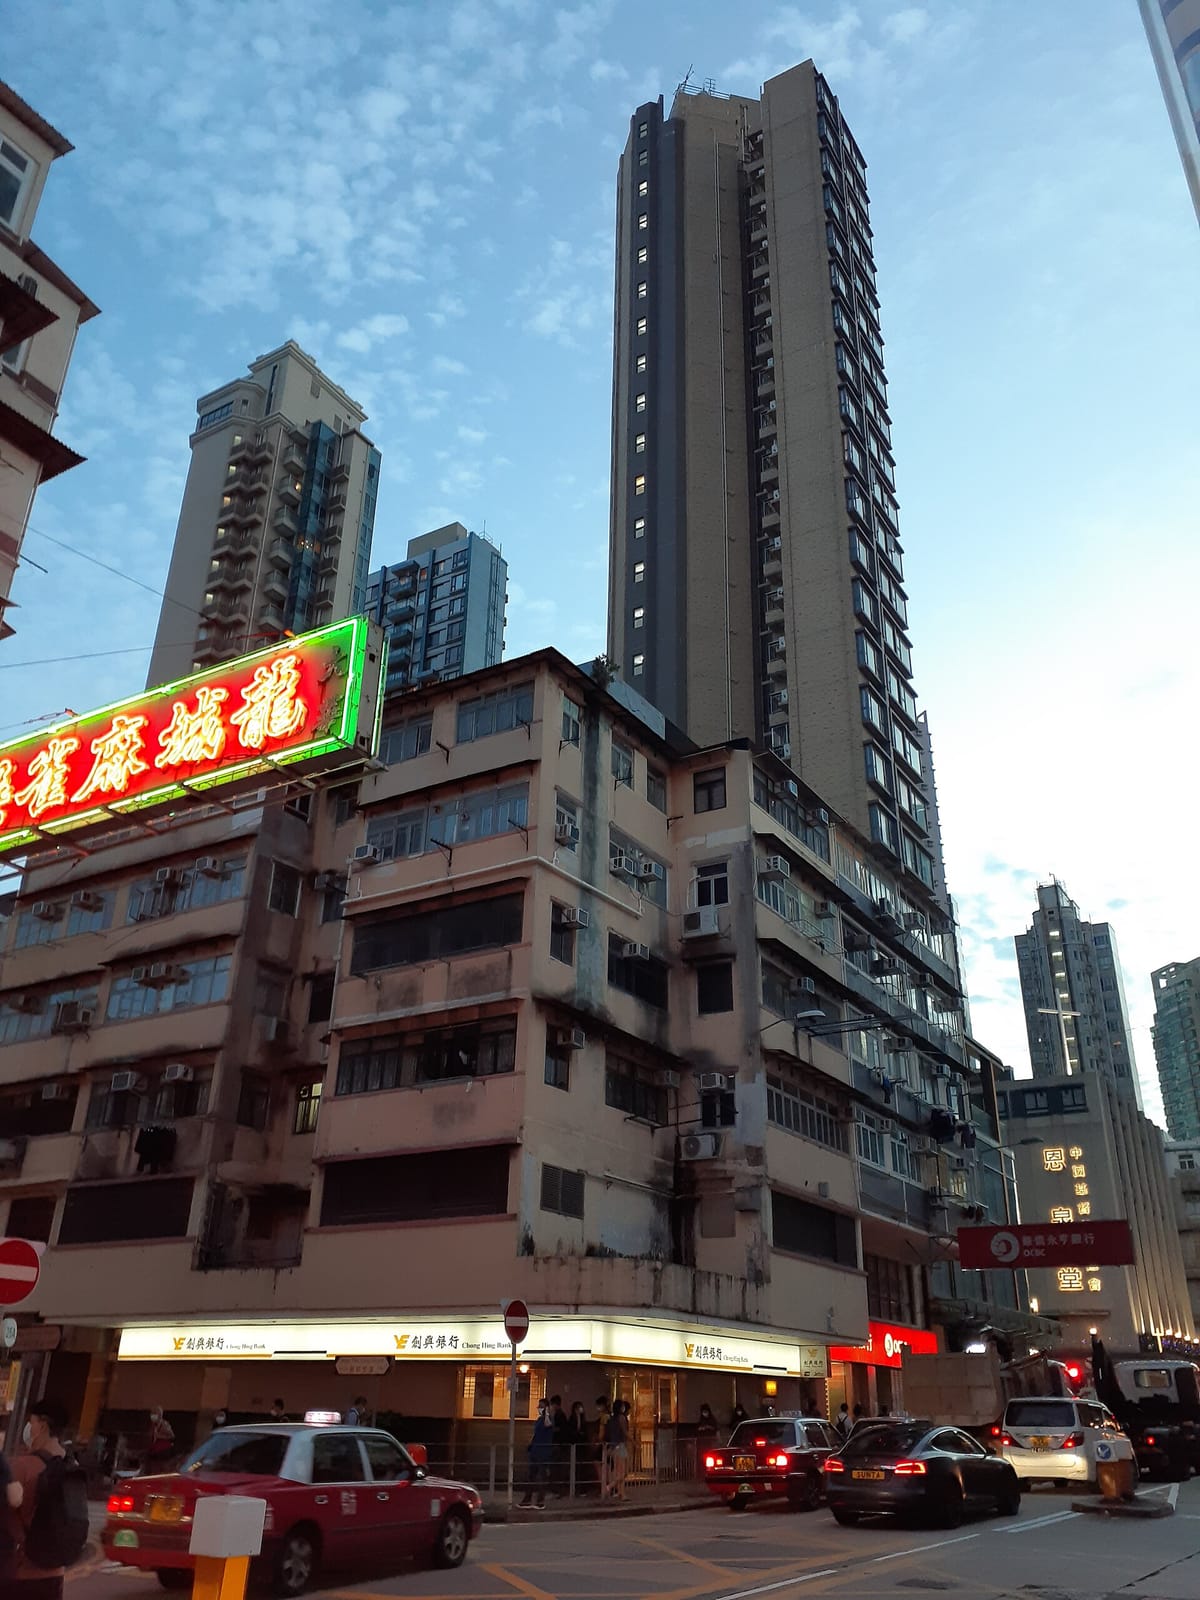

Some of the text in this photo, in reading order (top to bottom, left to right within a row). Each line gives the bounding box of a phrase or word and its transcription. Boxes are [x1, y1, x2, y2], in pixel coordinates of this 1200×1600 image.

[411, 1334, 460, 1350] 創興銀行
[497, 1341, 511, 1349] Bank
